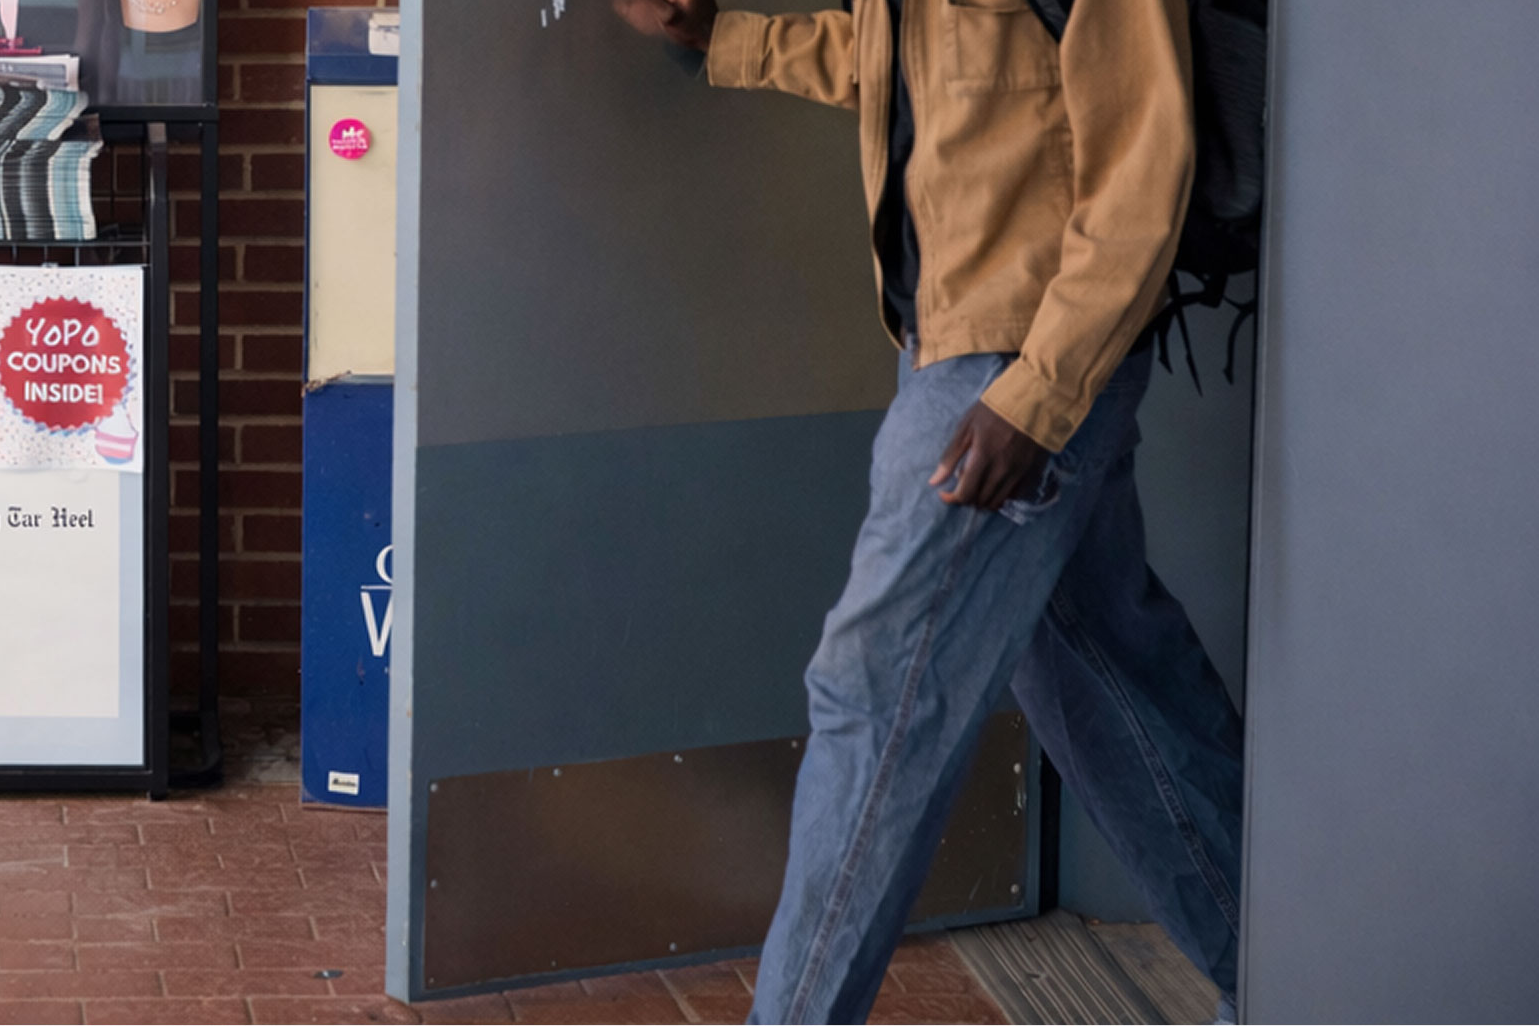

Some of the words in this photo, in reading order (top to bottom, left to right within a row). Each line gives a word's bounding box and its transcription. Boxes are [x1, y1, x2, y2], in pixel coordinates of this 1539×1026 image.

[6, 352, 121, 375] COUPONS
[24, 381, 104, 405] INSIDE!
[7, 505, 42, 528] Tar
[51, 505, 94, 528] Heel
